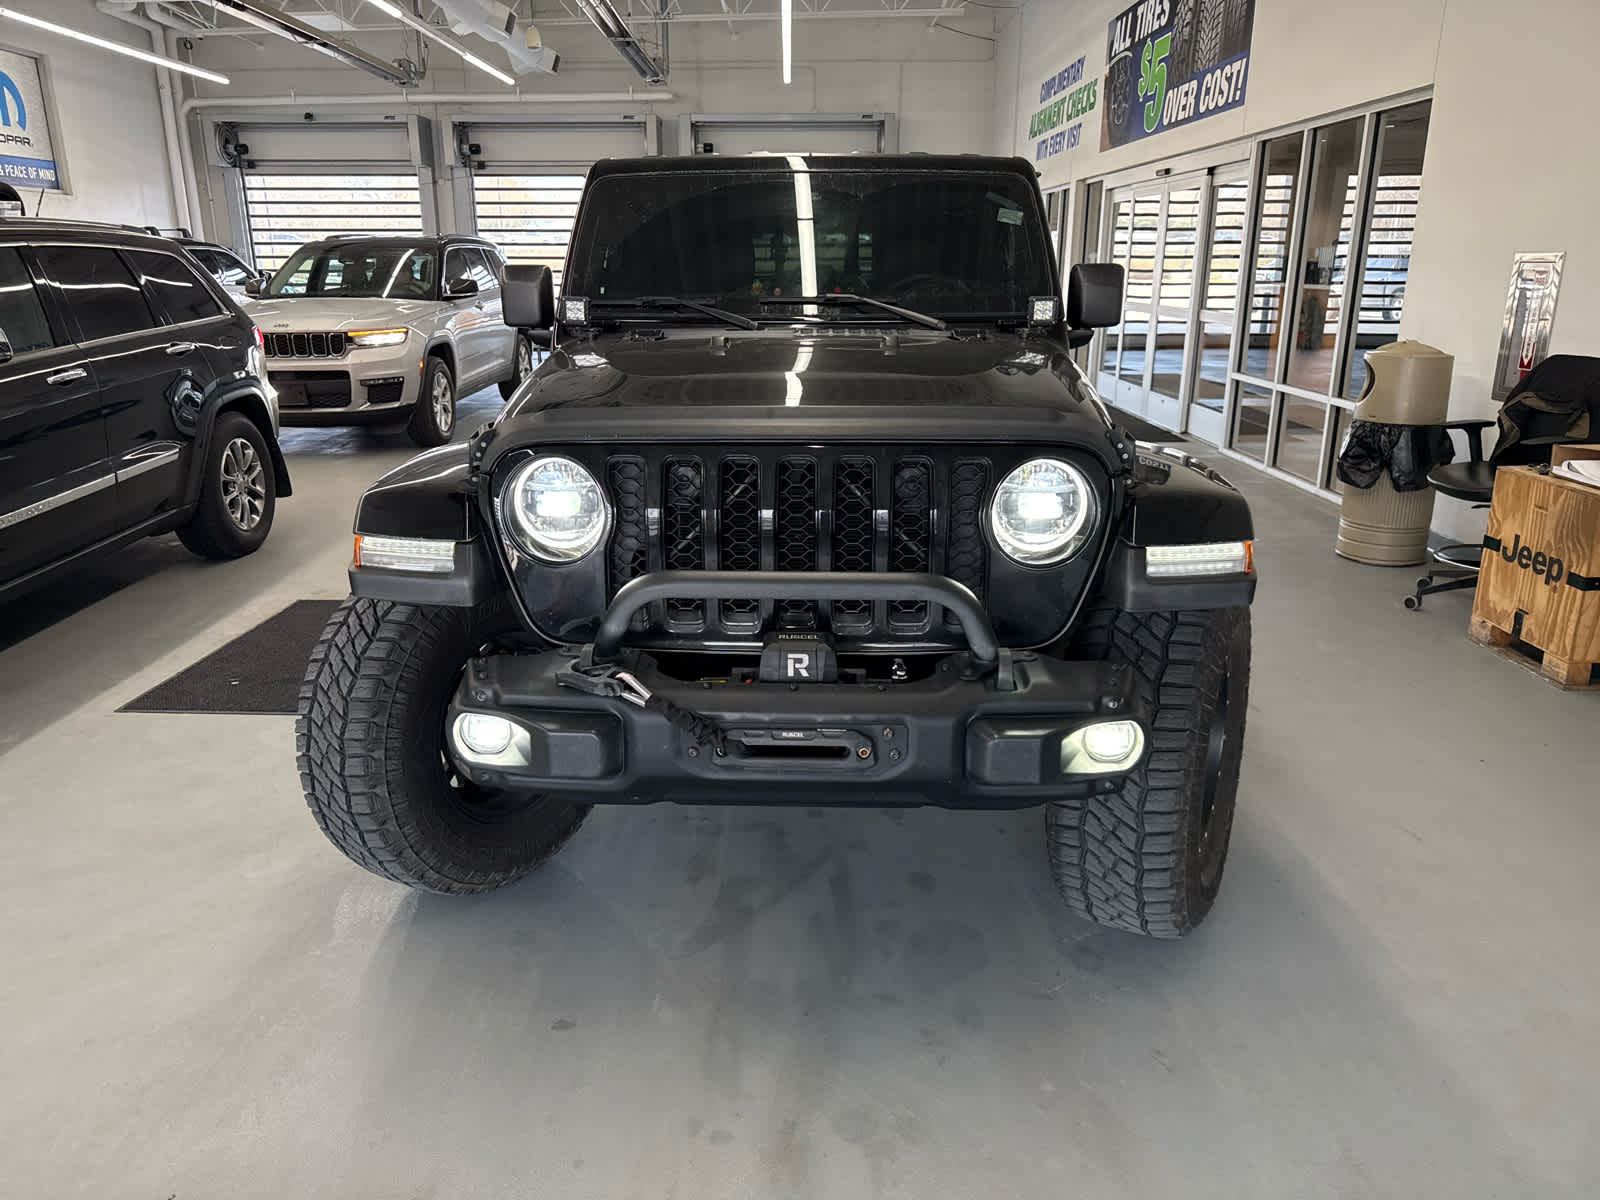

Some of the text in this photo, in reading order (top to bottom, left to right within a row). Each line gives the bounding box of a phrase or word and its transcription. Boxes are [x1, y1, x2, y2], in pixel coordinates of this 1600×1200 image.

[1111, 0, 1170, 57] ALL TIRES
[1028, 78, 1098, 140] ALIGNMENT CHECKS
[1138, 32, 1171, 133] $5
[1162, 57, 1247, 126] OVER COST!
[0, 134, 31, 147] OPAR
[1048, 130, 1067, 157] EVERY
[1066, 122, 1083, 150] VISIT
[5, 164, 28, 178] PEACE
[28, 167, 37, 180] OF
[38, 168, 55, 181] MIND
[1502, 533, 1564, 586] Jeep
[787, 653, 809, 677] R
